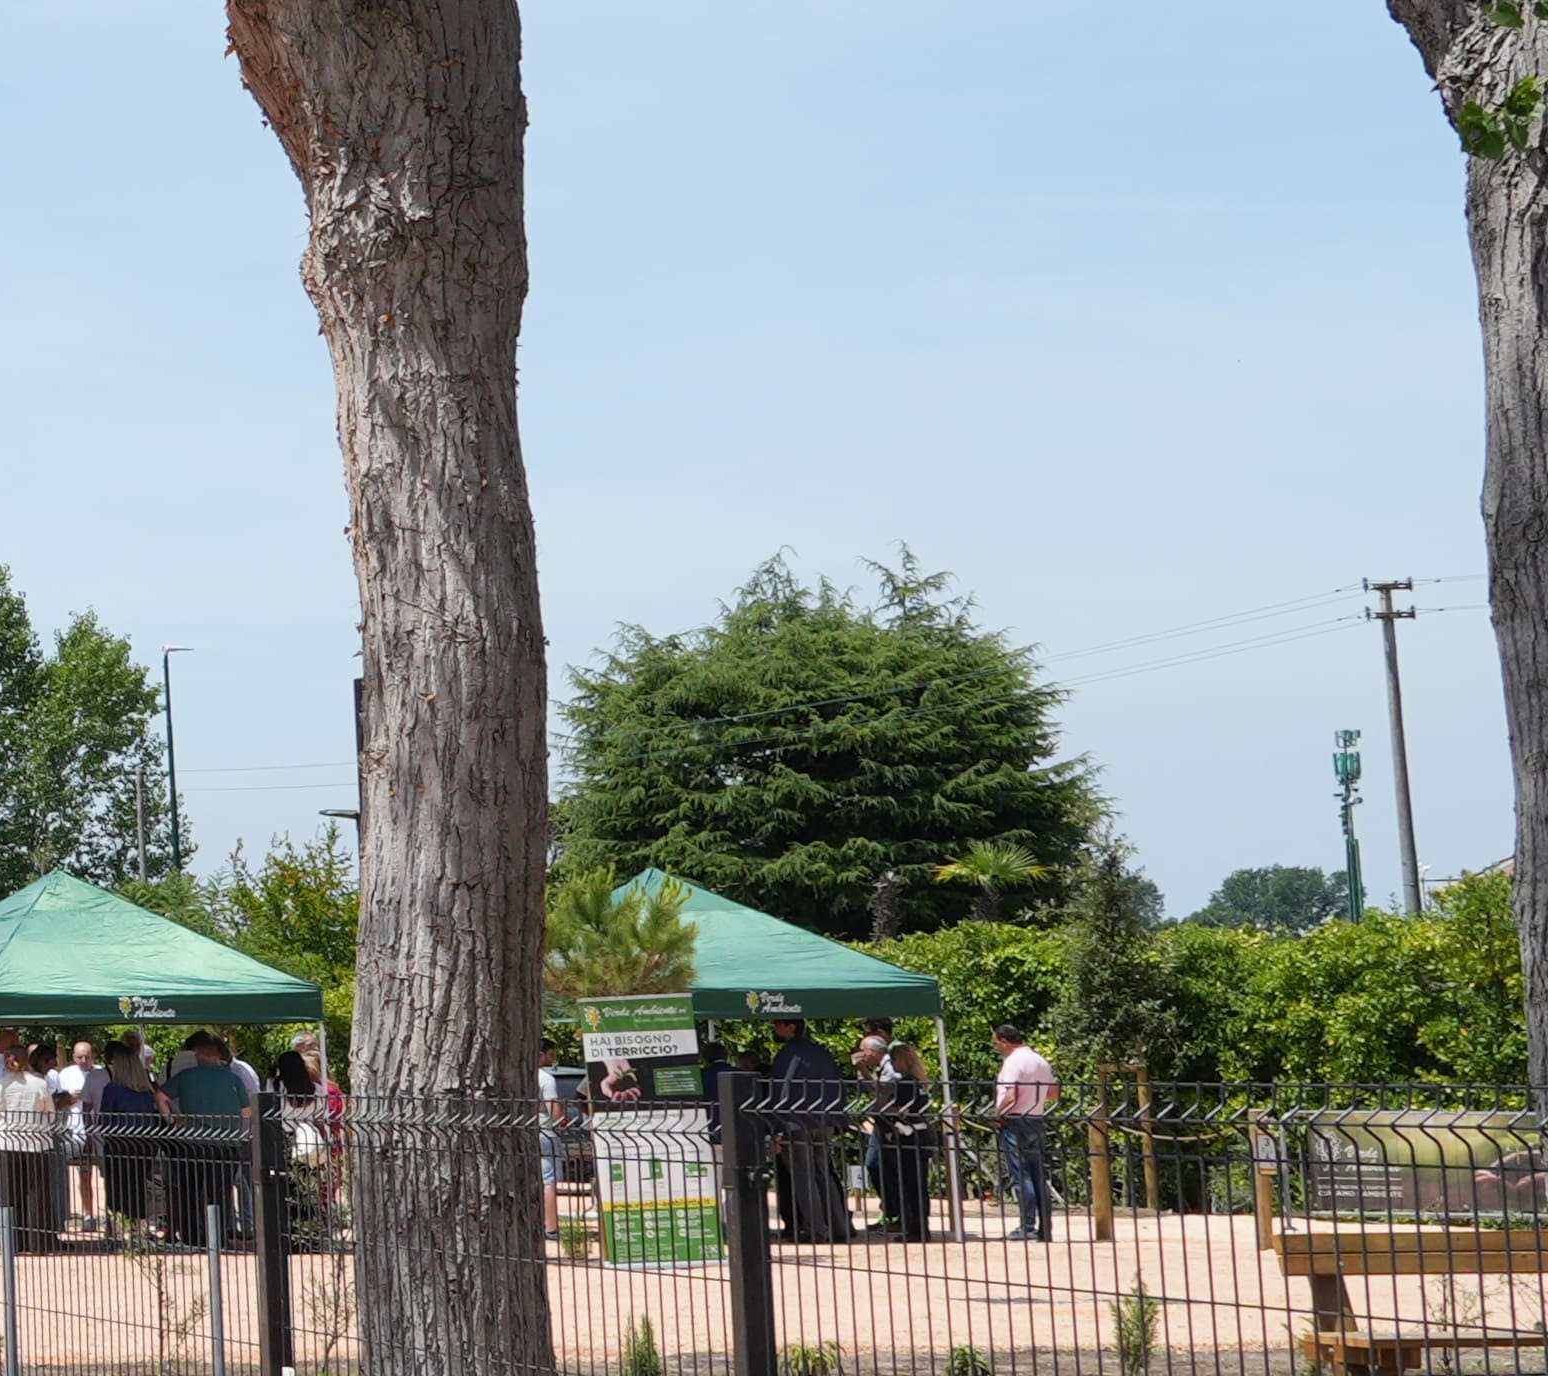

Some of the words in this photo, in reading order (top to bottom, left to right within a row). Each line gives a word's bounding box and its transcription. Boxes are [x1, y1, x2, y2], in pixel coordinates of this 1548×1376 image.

[589, 1036, 611, 1046] HAI
[614, 1034, 672, 1045] BISOGNO
[591, 1048, 604, 1058] DI
[606, 1044, 678, 1057] TERRICCIO?
